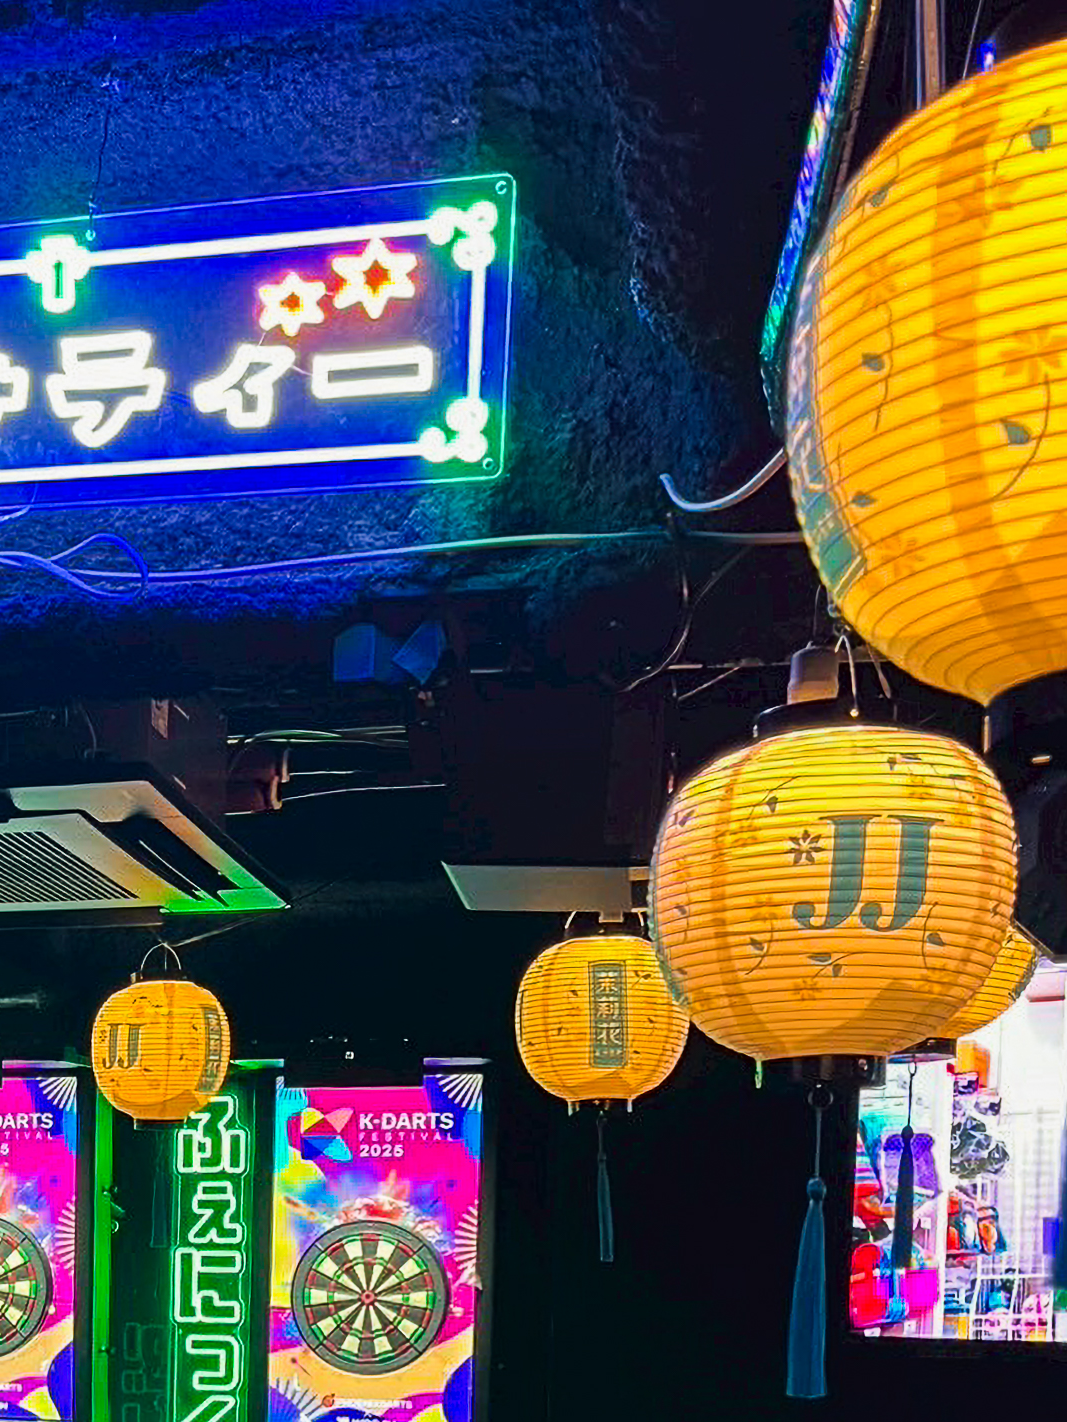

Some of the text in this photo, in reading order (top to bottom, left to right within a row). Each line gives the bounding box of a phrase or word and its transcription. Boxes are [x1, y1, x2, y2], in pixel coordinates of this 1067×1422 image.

[792, 814, 944, 932] JJ
[102, 1022, 142, 1070] JJ
[359, 1111, 455, 1130] K-DARTS
[359, 1143, 404, 1159] 2025
